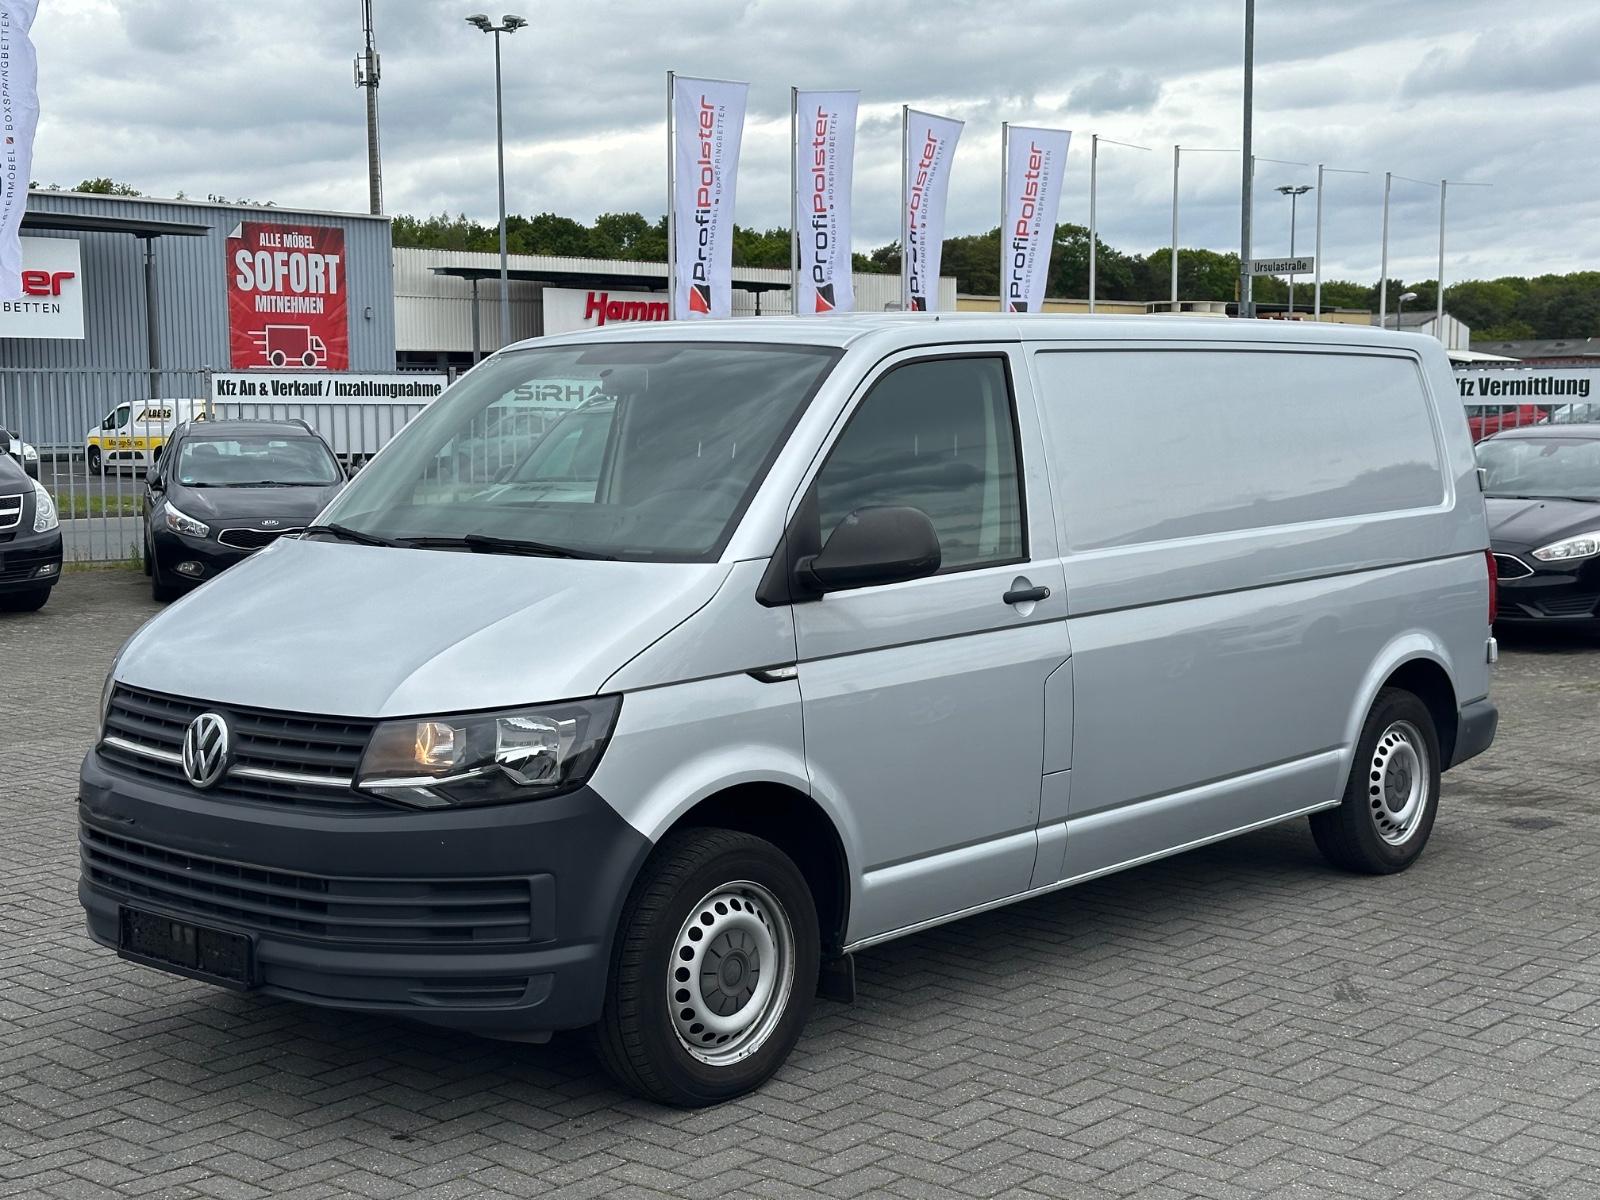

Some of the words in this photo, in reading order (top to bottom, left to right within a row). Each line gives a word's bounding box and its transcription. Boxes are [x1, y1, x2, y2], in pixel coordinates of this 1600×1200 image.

[0, 12, 13, 131] BOXSPRINGBETTEN
[693, 94, 714, 282] ProfiPolster
[812, 105, 828, 283] ProfiPolster
[1010, 141, 1042, 298] ProfiPolster
[260, 233, 281, 247] ALLE
[284, 232, 314, 249] MÖBEL
[235, 249, 339, 294] SOFORT
[1254, 260, 1307, 272] Ursulastraße
[255, 295, 324, 314] MITNEHMEN
[217, 379, 237, 396] Kfz
[239, 379, 256, 396] An
[259, 381, 269, 396] &
[270, 379, 323, 397] Verkauf
[325, 380, 332, 397] /
[334, 381, 442, 398] Inzahlungnahme
[1478, 376, 1590, 397] Vermittlung
